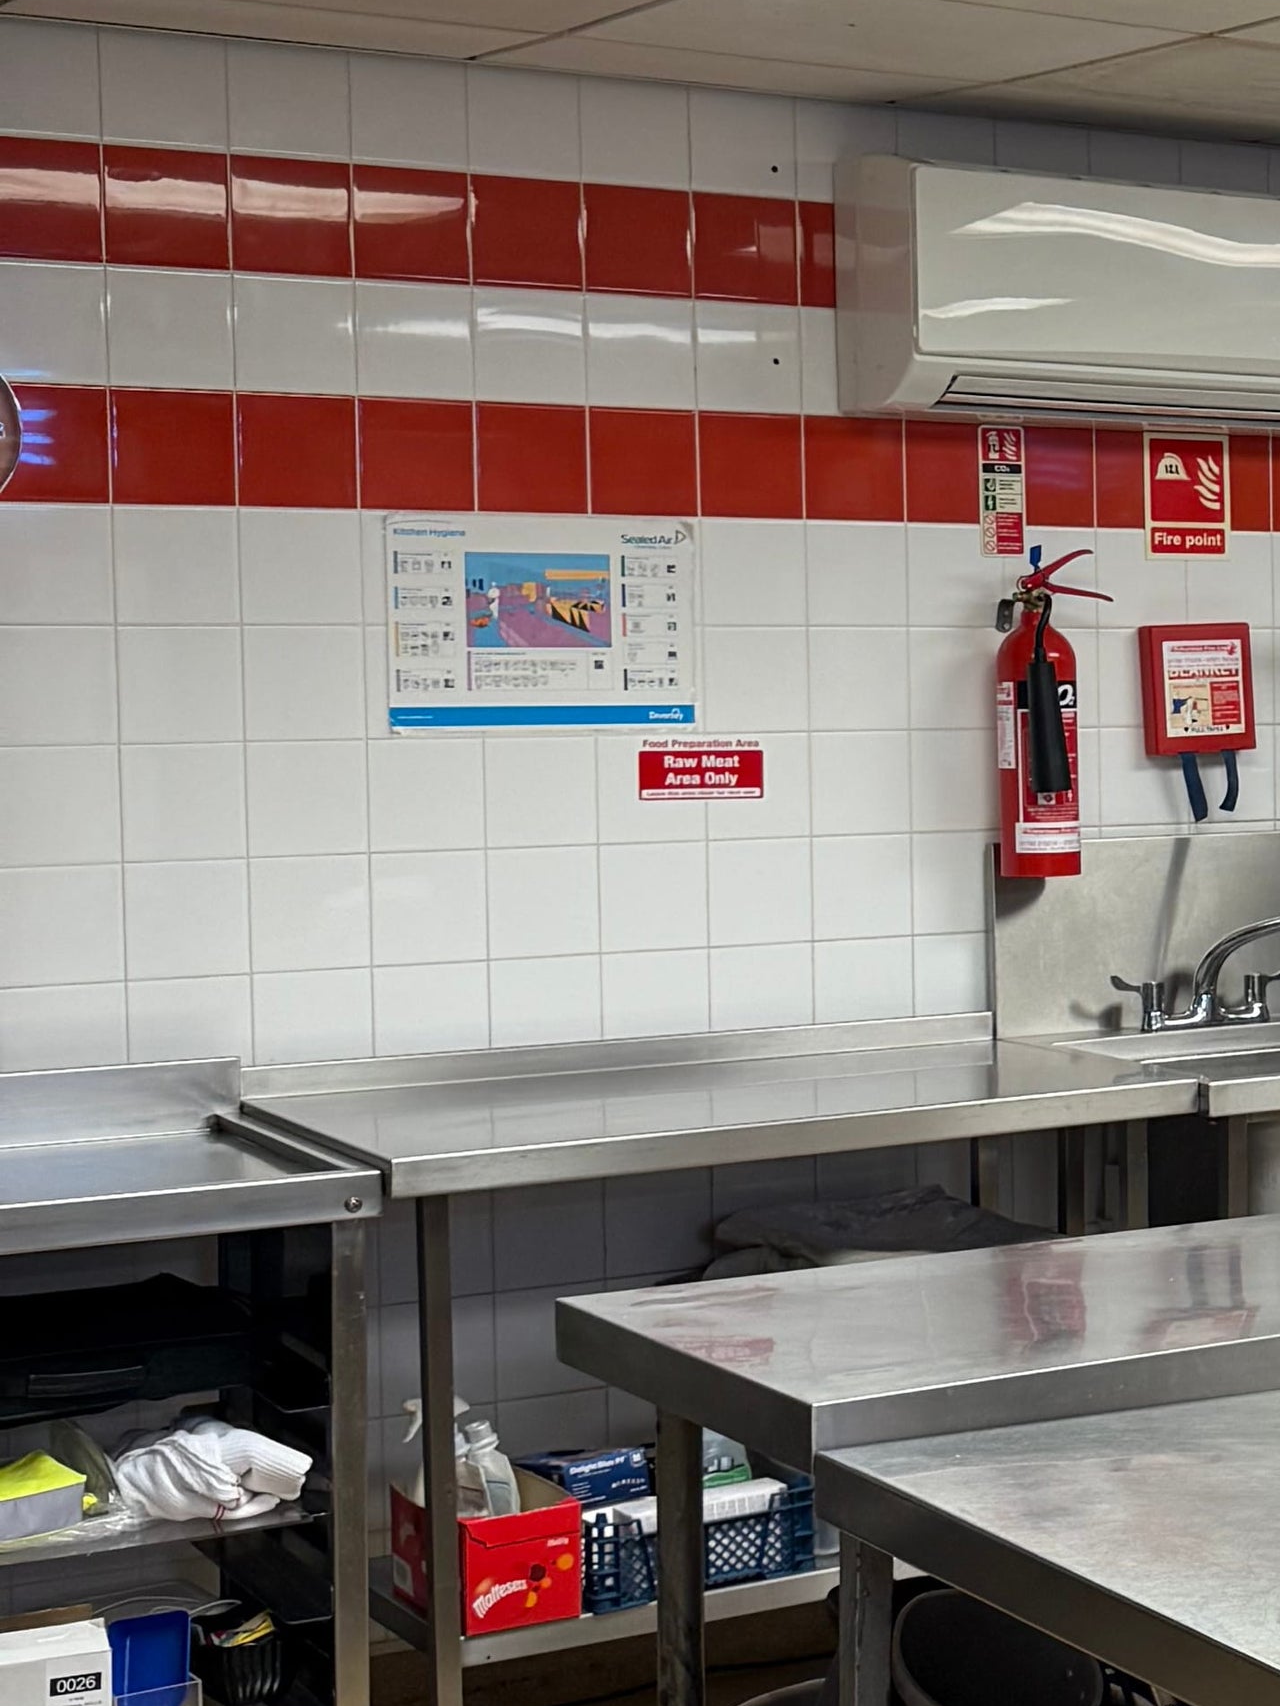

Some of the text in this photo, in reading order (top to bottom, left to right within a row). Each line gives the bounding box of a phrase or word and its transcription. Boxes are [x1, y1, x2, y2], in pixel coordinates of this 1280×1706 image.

[1154, 532, 1222, 549] Fire point
[642, 739, 760, 749] Food Preparation Area
[664, 755, 740, 769] Raw Meat
[664, 771, 739, 786] Area Only
[57, 1675, 97, 1693] 0026
